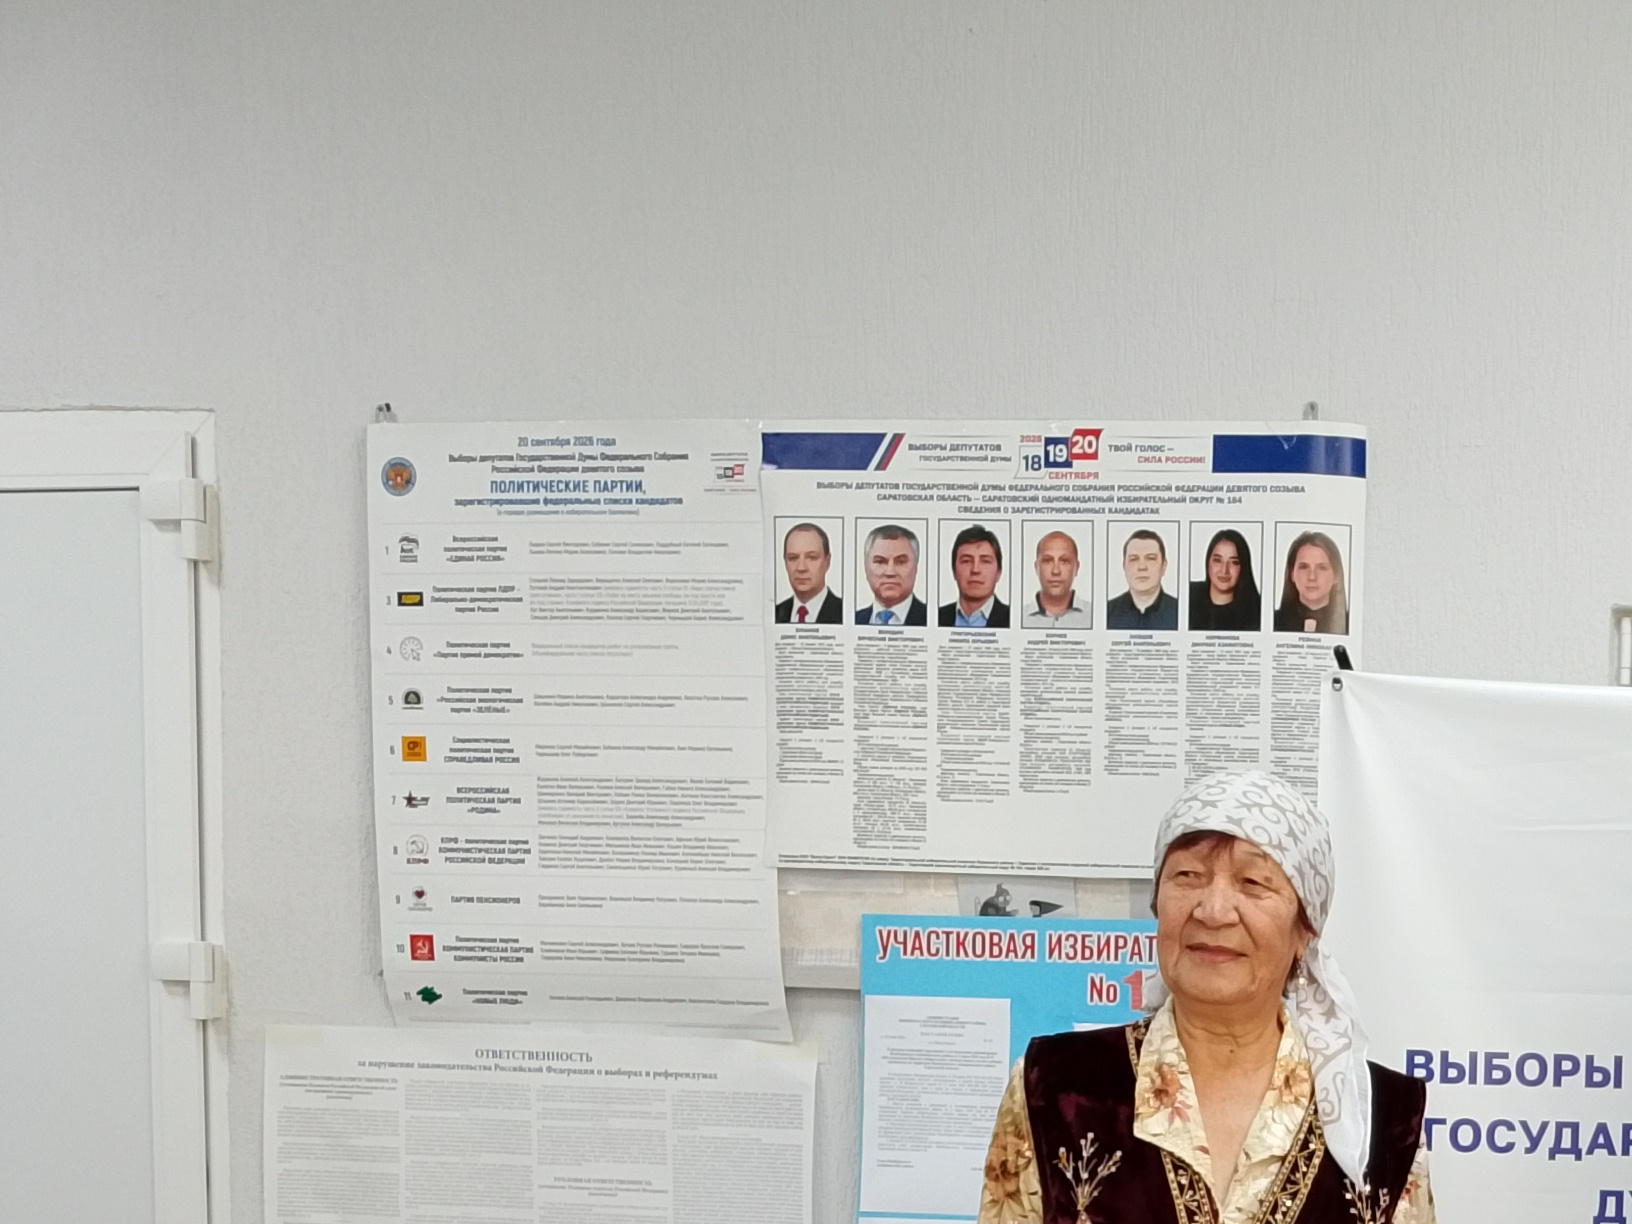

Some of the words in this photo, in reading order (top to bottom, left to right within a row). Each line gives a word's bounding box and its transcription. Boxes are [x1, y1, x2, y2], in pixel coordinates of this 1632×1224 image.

[518, 436, 528, 447] 20
[531, 437, 570, 448] сентября
[573, 436, 594, 446] 2026
[596, 437, 616, 446] года
[1020, 435, 1042, 443] 2026
[1071, 435, 1097, 454] 20
[908, 443, 946, 452] ВЫБОРЫ
[949, 444, 1002, 453] ДЕПУТАТОВ
[1047, 442, 1067, 463] 19
[1108, 442, 1132, 453] ТВОЙ
[1134, 444, 1165, 453] ГОЛОС
[1022, 454, 1042, 472] 18
[1137, 456, 1162, 464] СИЛА
[1165, 456, 1205, 465] РОССИИ!
[1048, 471, 1099, 480] СЕНТЯБРЯ
[490, 480, 589, 494] ПОЛИТИЧЕСКИЕ
[593, 480, 646, 495] ПАРТИИ,
[817, 482, 853, 490] ВЫБОРЫ
[855, 482, 900, 491] ДЕПУТАТОВ
[902, 482, 979, 491] ГОСУДАРСТВЕННОЙ
[981, 483, 1006, 492] ДУМЫ
[1008, 484, 1070, 493] ФЕДЕРАЛЬНОГО
[1072, 484, 1115, 492] СОБРАНИЯ
[1117, 484, 1173, 492] РОССИЙСКОЙ
[1175, 485, 1224, 494] ФЕДЕРАЦИИ
[1225, 485, 1267, 494] ДЕВЯТОГО
[877, 494, 934, 502] САРАТОВСКАЯ
[936, 494, 972, 502] ОБЛАСТЬ
[982, 494, 1039, 503] САРАТОВСКИЙ
[1116, 495, 1187, 504] ИЗБИРАТЕЛЬНЫЙ
[1189, 496, 1214, 505] ОКРУГ
[877, 928, 1036, 961] УЧАСТКОВАЯ
[1046, 932, 1158, 963] ИЗБИРАТ
[475, 1048, 594, 1063] ОТВЕТСТВЕННОСТЬ
[1406, 1049, 1623, 1089] ВЫБОРЫ
